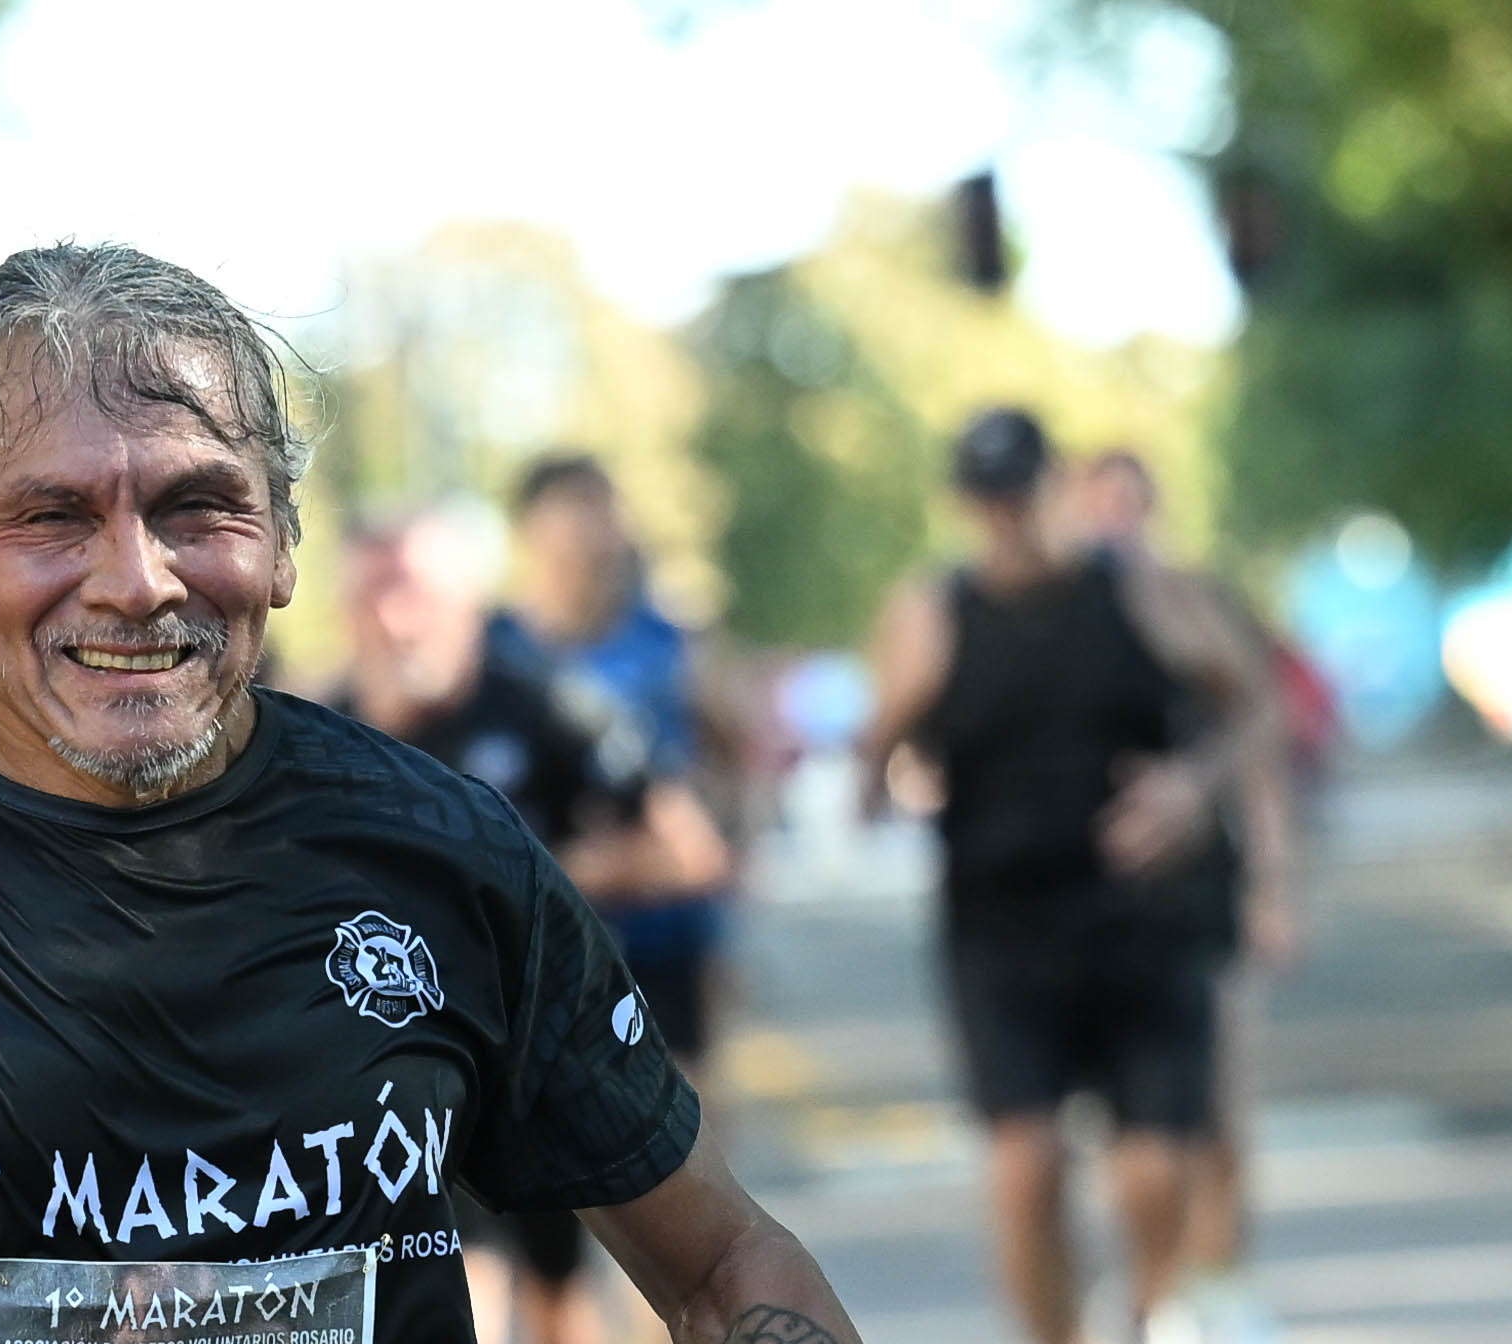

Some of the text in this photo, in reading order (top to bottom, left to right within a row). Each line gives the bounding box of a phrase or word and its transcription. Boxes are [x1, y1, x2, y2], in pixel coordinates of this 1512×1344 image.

[42, 1080, 453, 1244] MARATÓN
[400, 1228, 463, 1260] ROSA
[100, 1271, 321, 1331] MARATÓN
